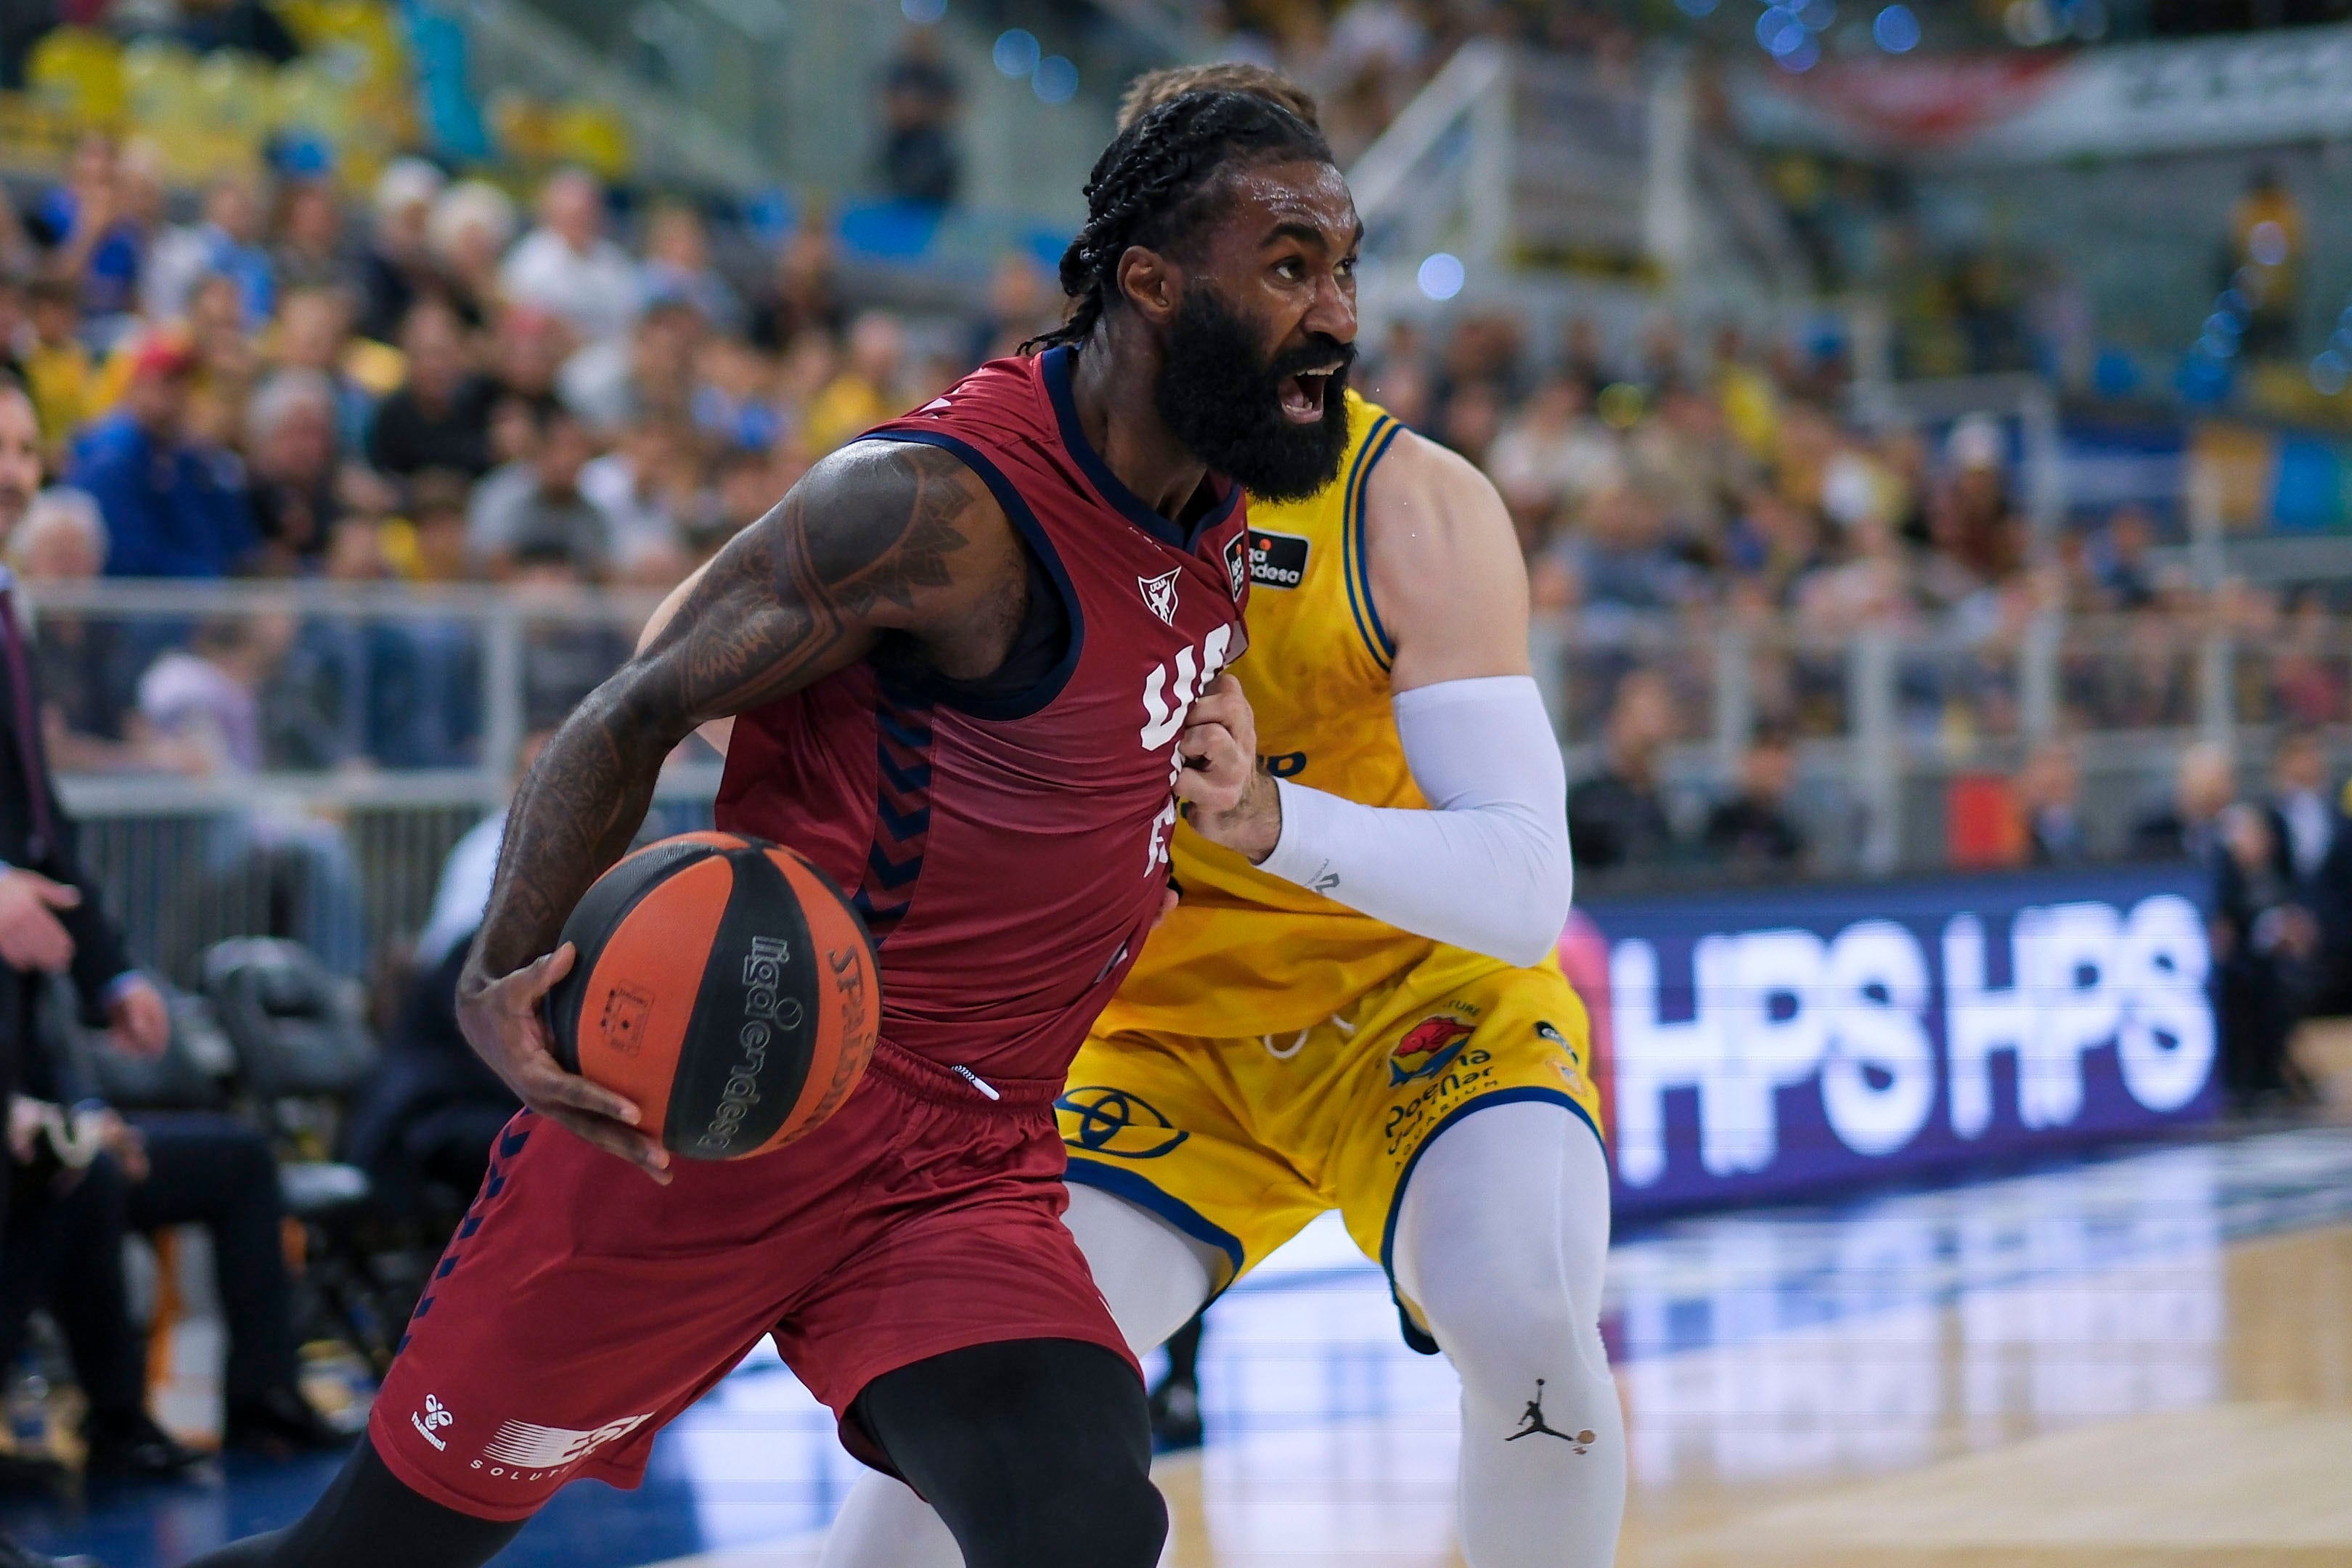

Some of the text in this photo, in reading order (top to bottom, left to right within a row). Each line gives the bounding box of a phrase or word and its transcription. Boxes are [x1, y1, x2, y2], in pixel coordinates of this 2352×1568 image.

[1611, 894, 2217, 1187] HPS HPS
[410, 1410, 446, 1452] hummel
[470, 1458, 569, 1482] SOLUTI
